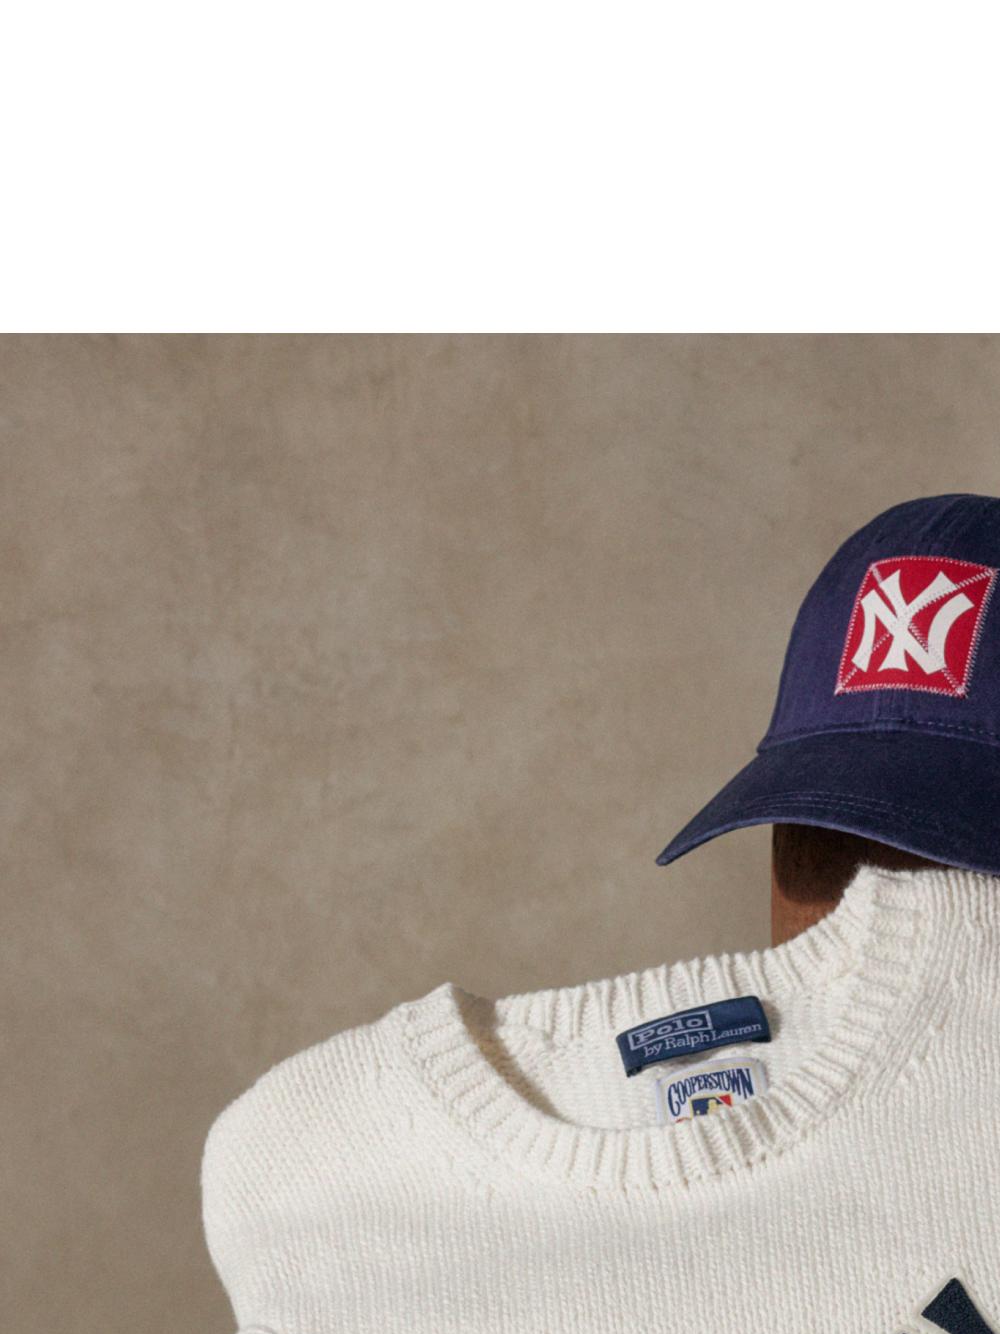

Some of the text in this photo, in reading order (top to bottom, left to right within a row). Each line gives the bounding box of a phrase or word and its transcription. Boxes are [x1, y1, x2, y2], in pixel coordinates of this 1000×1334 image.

[634, 1017, 704, 1044] Polo
[644, 1023, 762, 1058] by Ralph Lauren
[667, 1067, 755, 1117] COOPERSTOWN
